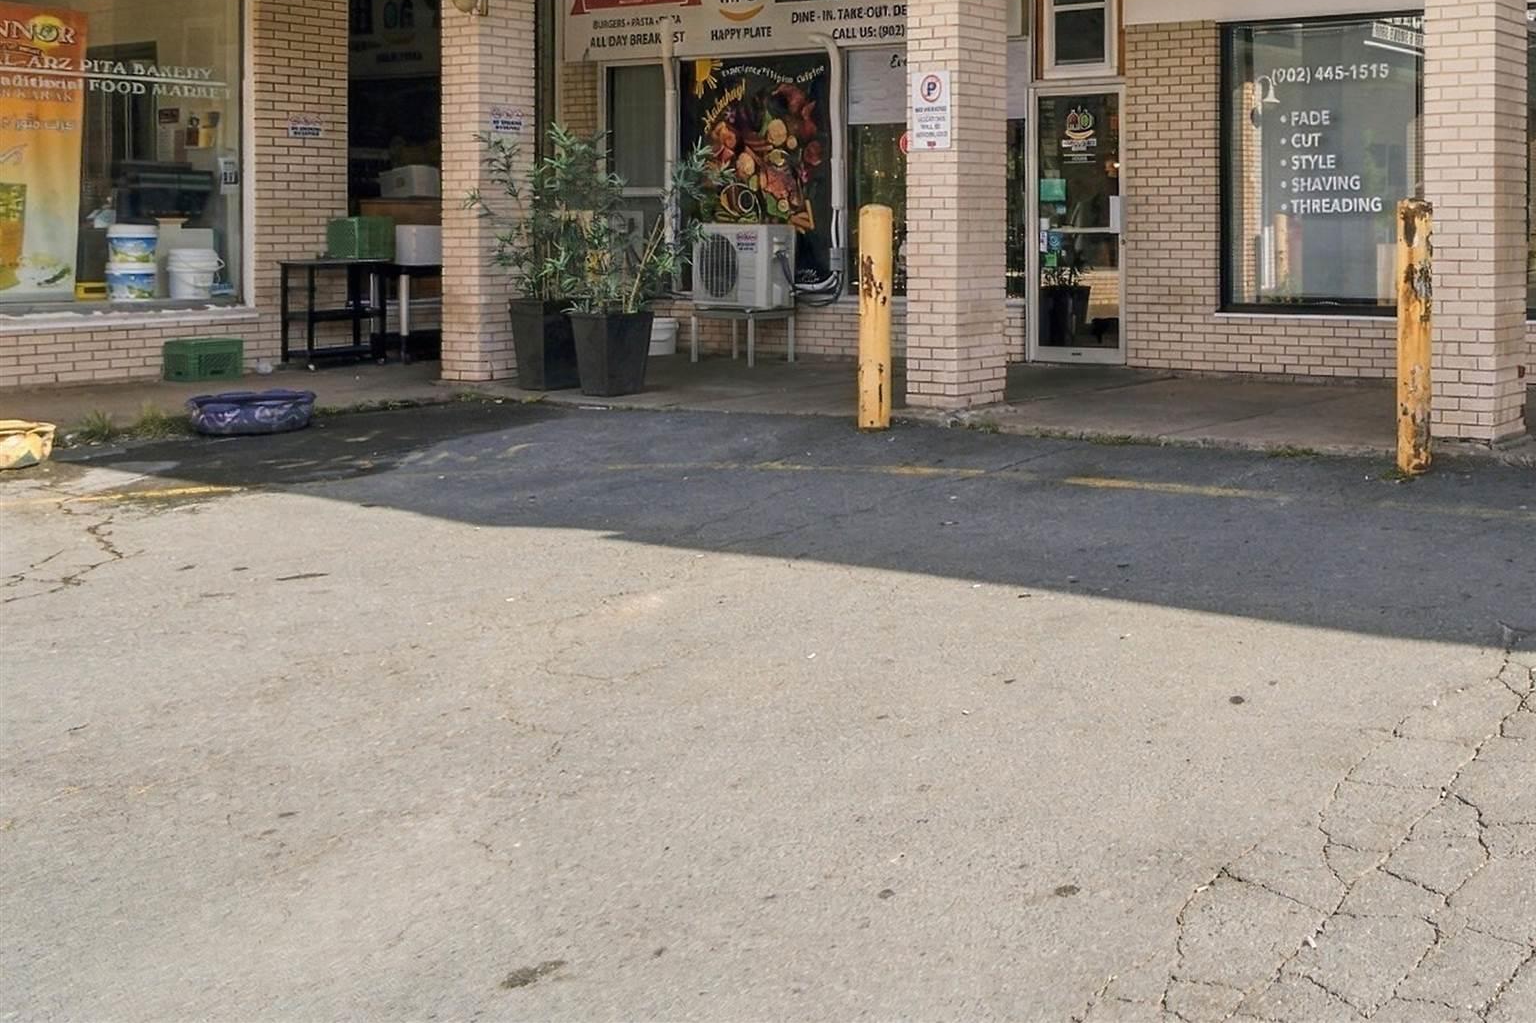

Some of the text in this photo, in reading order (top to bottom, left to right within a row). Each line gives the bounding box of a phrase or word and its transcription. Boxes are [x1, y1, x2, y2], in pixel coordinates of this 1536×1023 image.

[593, 17, 626, 29] BURGERS
[631, 15, 654, 27] PASTA
[791, 11, 815, 24] DINE
[590, 31, 685, 48] ALL DAY BREAKST
[711, 26, 772, 41] HAPPY PLATE
[832, 24, 905, 40] CALL US: (902)
[80, 59, 127, 75] PITA
[132, 63, 216, 80] BAKERY
[796, 65, 825, 83] Cuisine
[1271, 63, 1390, 85] (902) 445-1515
[89, 79, 147, 96] FOOD
[152, 84, 232, 100] MARKET
[1291, 110, 1331, 126] FADE
[1291, 133, 1322, 148] CUT
[1291, 155, 1336, 170] STYLE
[1291, 176, 1361, 192] SHAVING
[1291, 197, 1382, 213] THREADING
